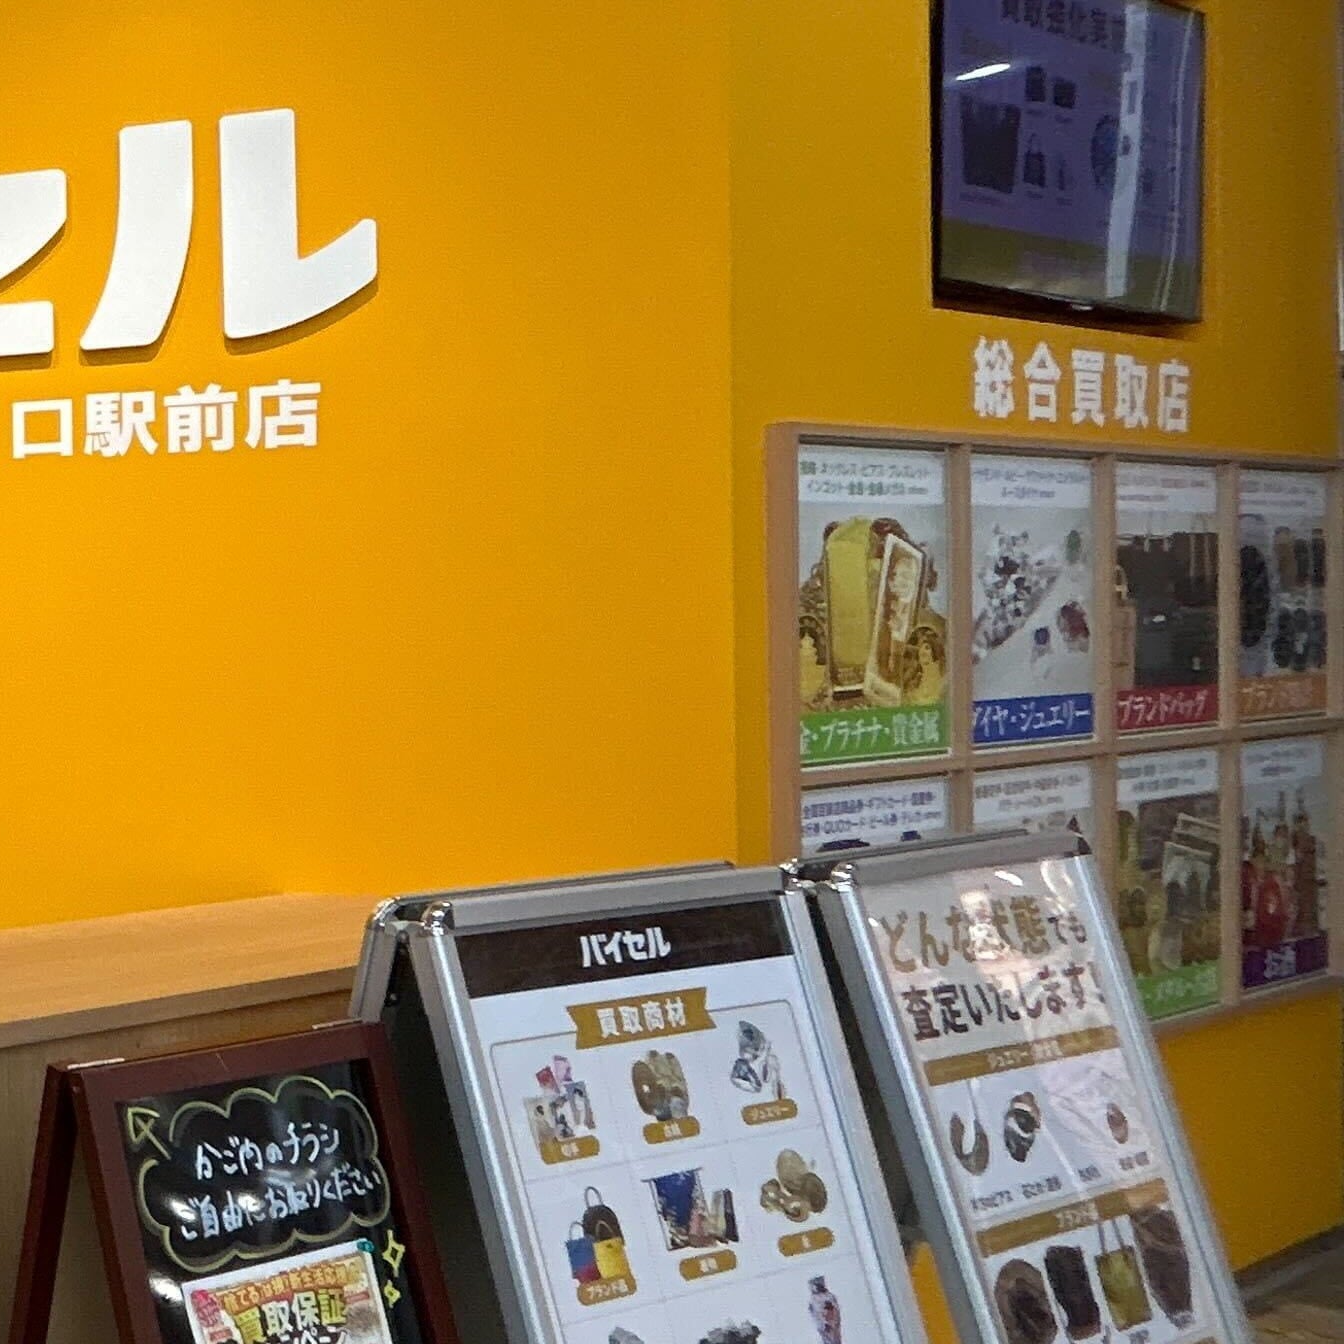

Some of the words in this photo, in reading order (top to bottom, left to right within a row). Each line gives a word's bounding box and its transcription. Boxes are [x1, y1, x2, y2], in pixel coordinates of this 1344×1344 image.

[973, 336, 1190, 433] 総合買取店
[579, 927, 671, 968] バイセル
[596, 997, 686, 1039] 買取商材
[196, 1122, 339, 1180] かご内のチラシ
[181, 1162, 381, 1240] ご自由にお取りください
[235, 1289, 346, 1344] 買取保証
